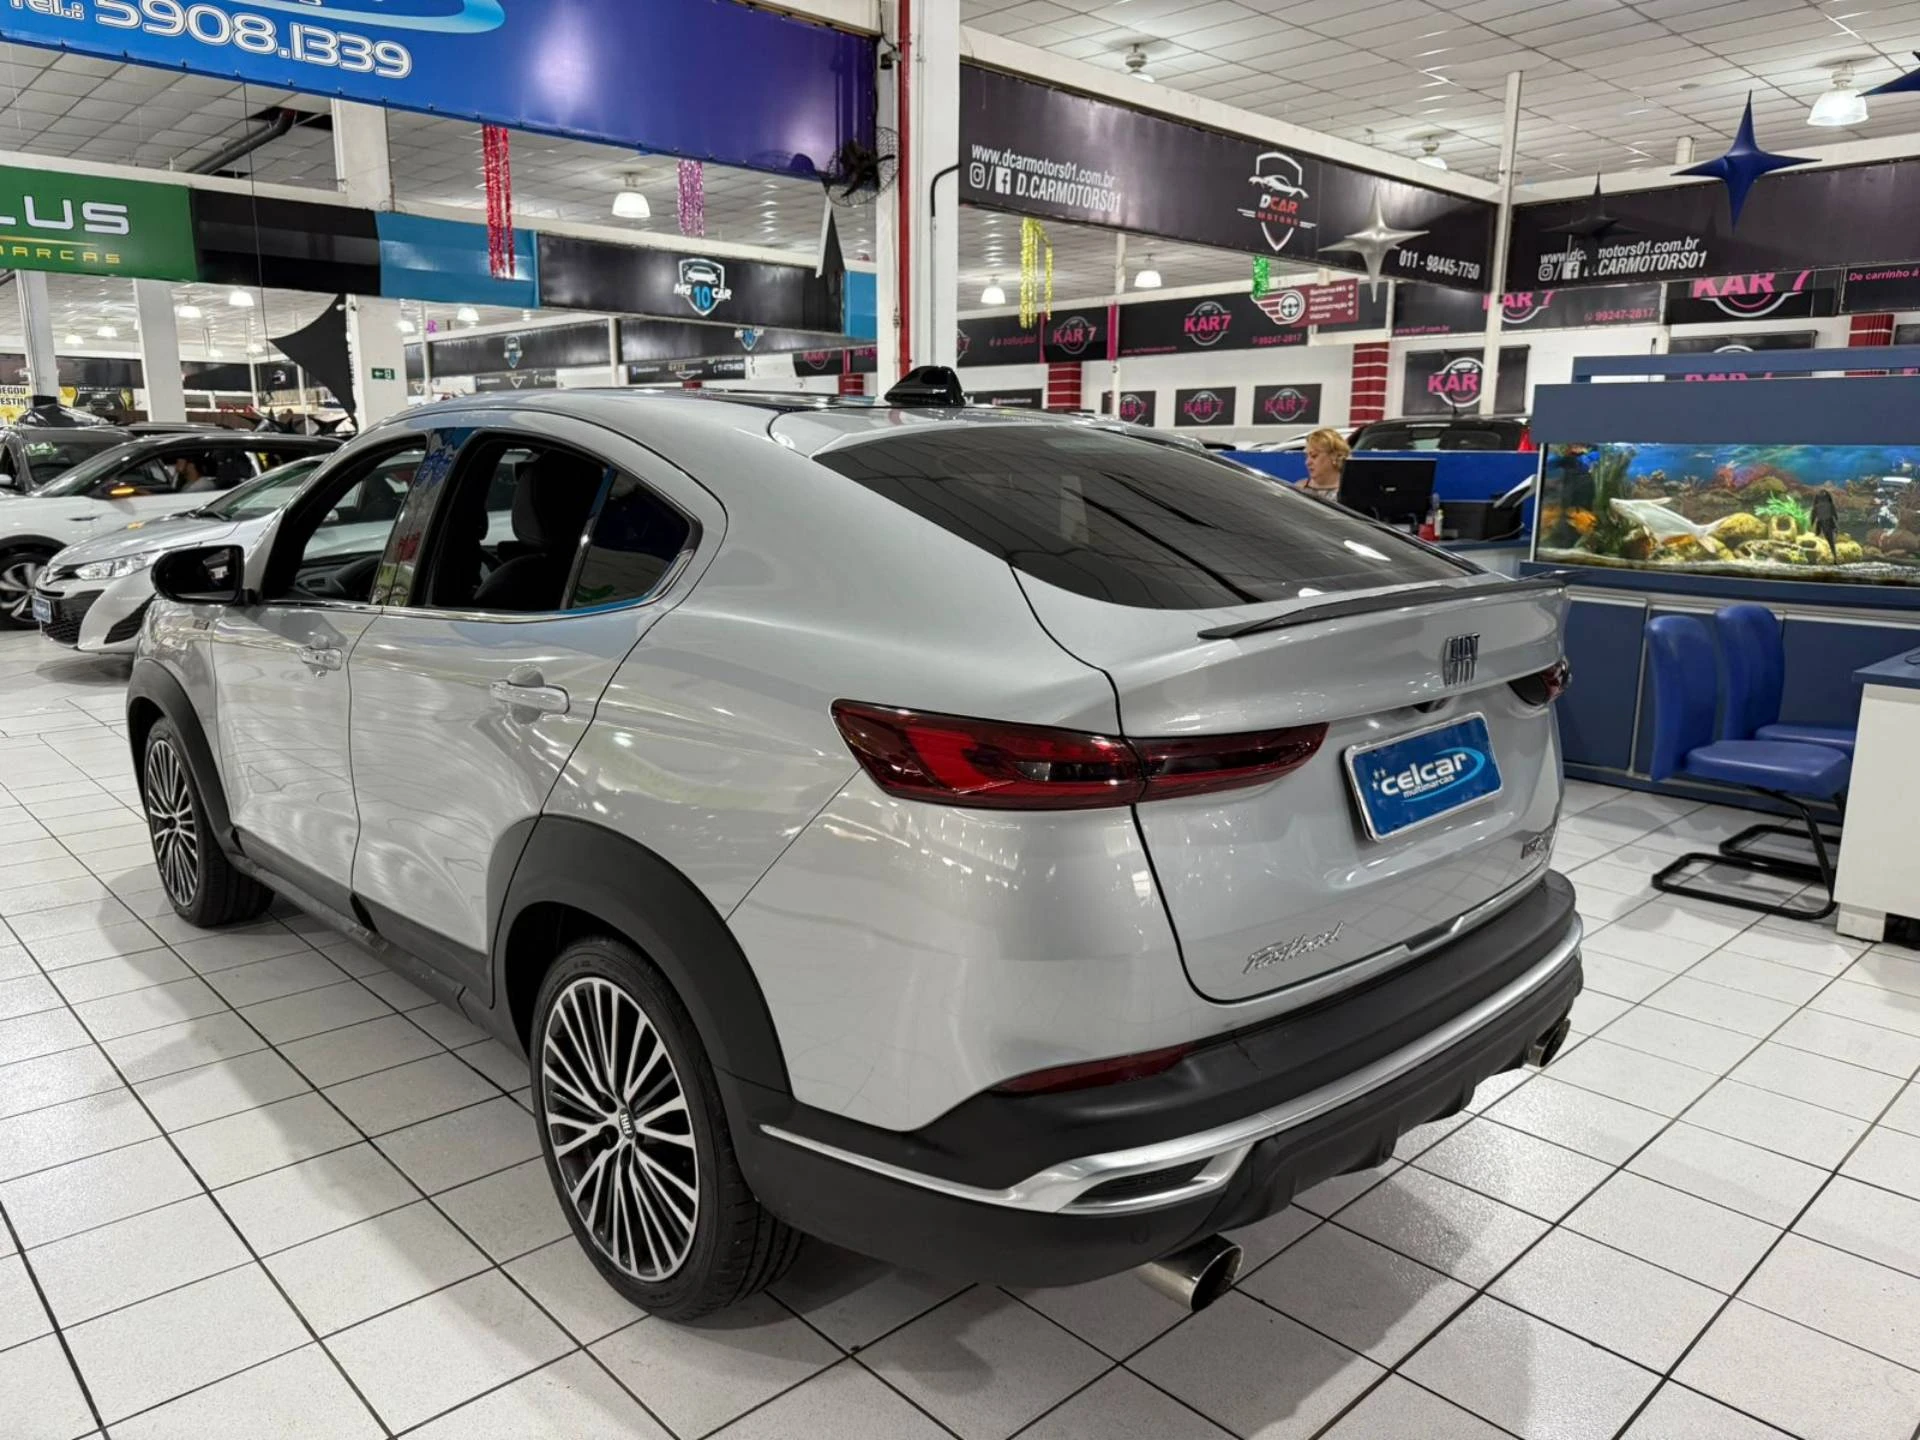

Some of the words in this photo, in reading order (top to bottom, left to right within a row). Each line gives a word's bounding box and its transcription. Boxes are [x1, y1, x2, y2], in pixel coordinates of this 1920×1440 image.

[95, 0, 412, 79] 5908.1339
[971, 143, 1115, 188] www.dcarmotors01.com.br
[1016, 173, 1122, 214] D.CARMOTORS01
[0, 195, 130, 236] US
[0, 245, 121, 265] ARCAS
[1399, 249, 1418, 268] 011
[1425, 254, 1480, 280] 98445-7750
[1692, 272, 1776, 298] KAR
[1052, 327, 1084, 344] KAR
[1087, 326, 1097, 341] 7
[1427, 372, 1480, 394] KAR
[1380, 752, 1467, 796] celcar
[1402, 774, 1456, 799] multimarcas
